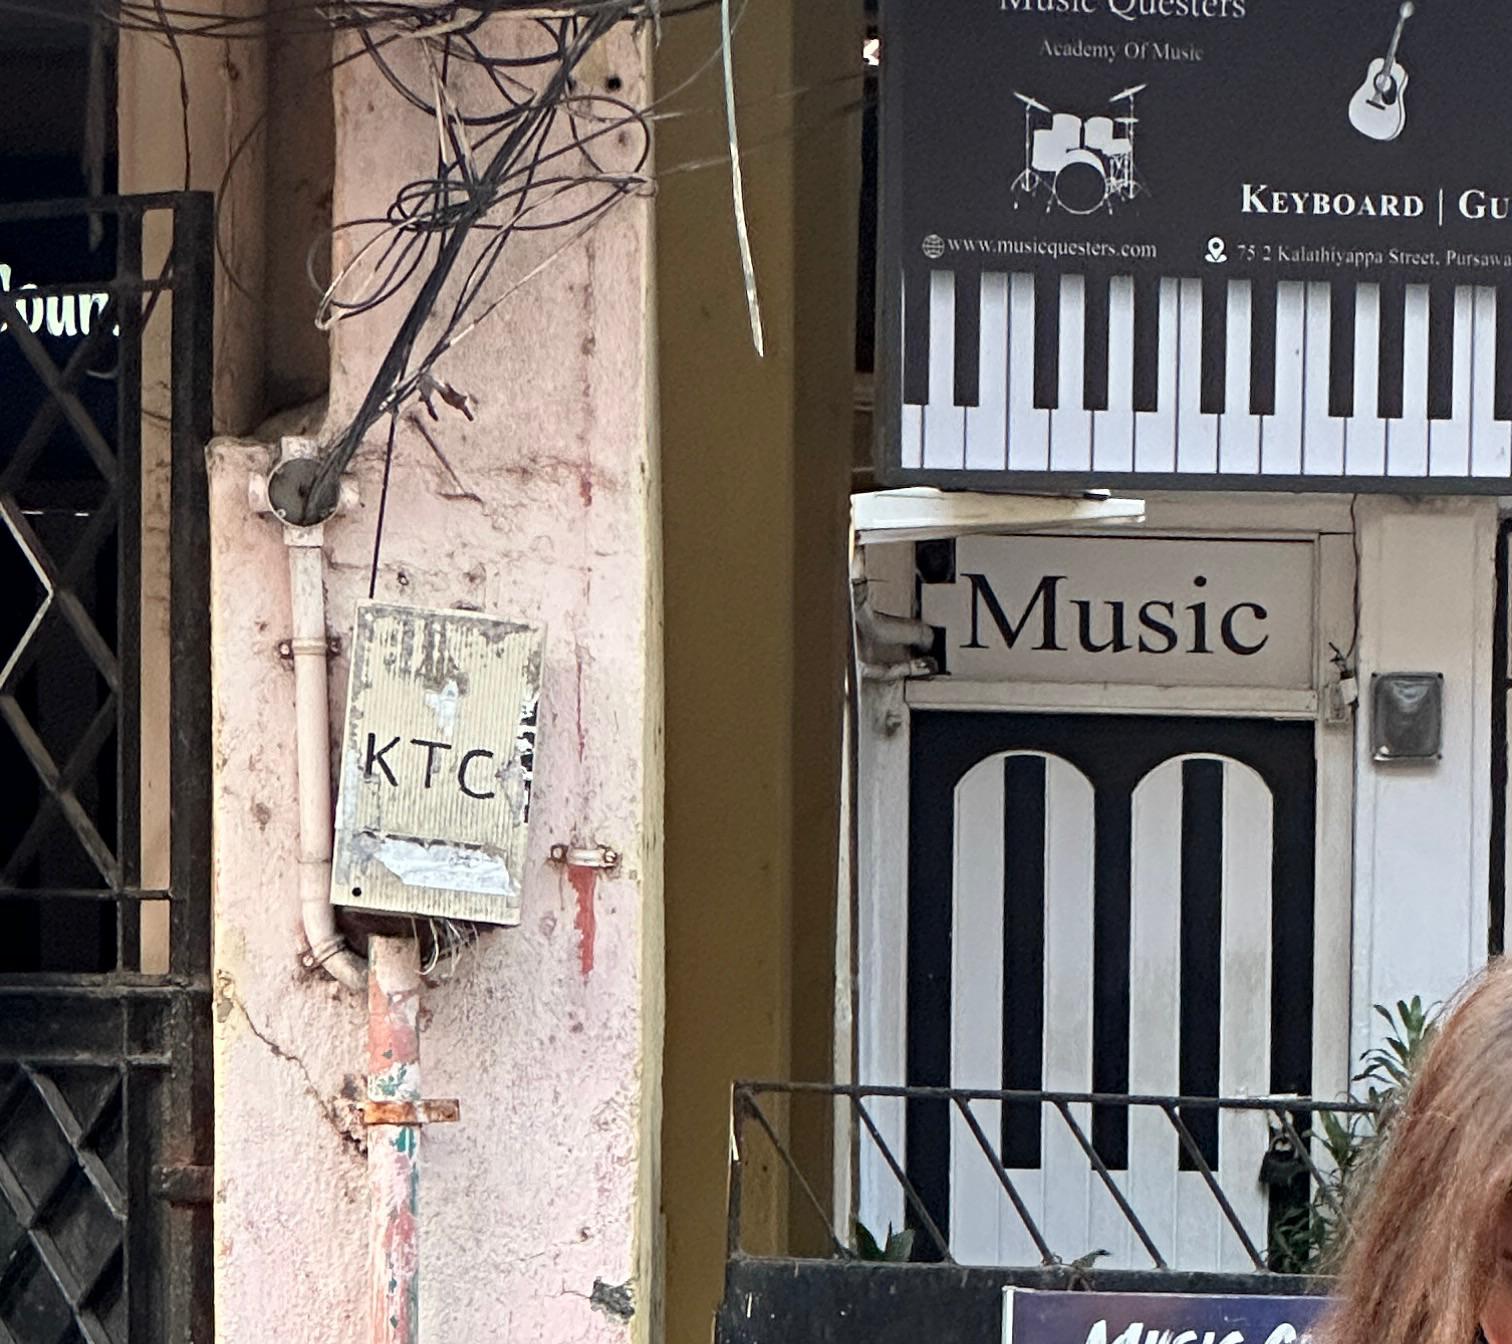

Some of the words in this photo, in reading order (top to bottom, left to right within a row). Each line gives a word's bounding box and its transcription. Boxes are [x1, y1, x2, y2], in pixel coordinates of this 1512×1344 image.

[1041, 40, 1117, 63] Academy
[1124, 42, 1149, 60] Of
[1152, 43, 1204, 62] Music
[1241, 184, 1424, 217] KEYBOARD
[948, 236, 1158, 260] www.musicquesters.com
[1278, 245, 1384, 267] Kalathiyappa
[959, 573, 1270, 656] Music
[365, 732, 495, 801] KTC
